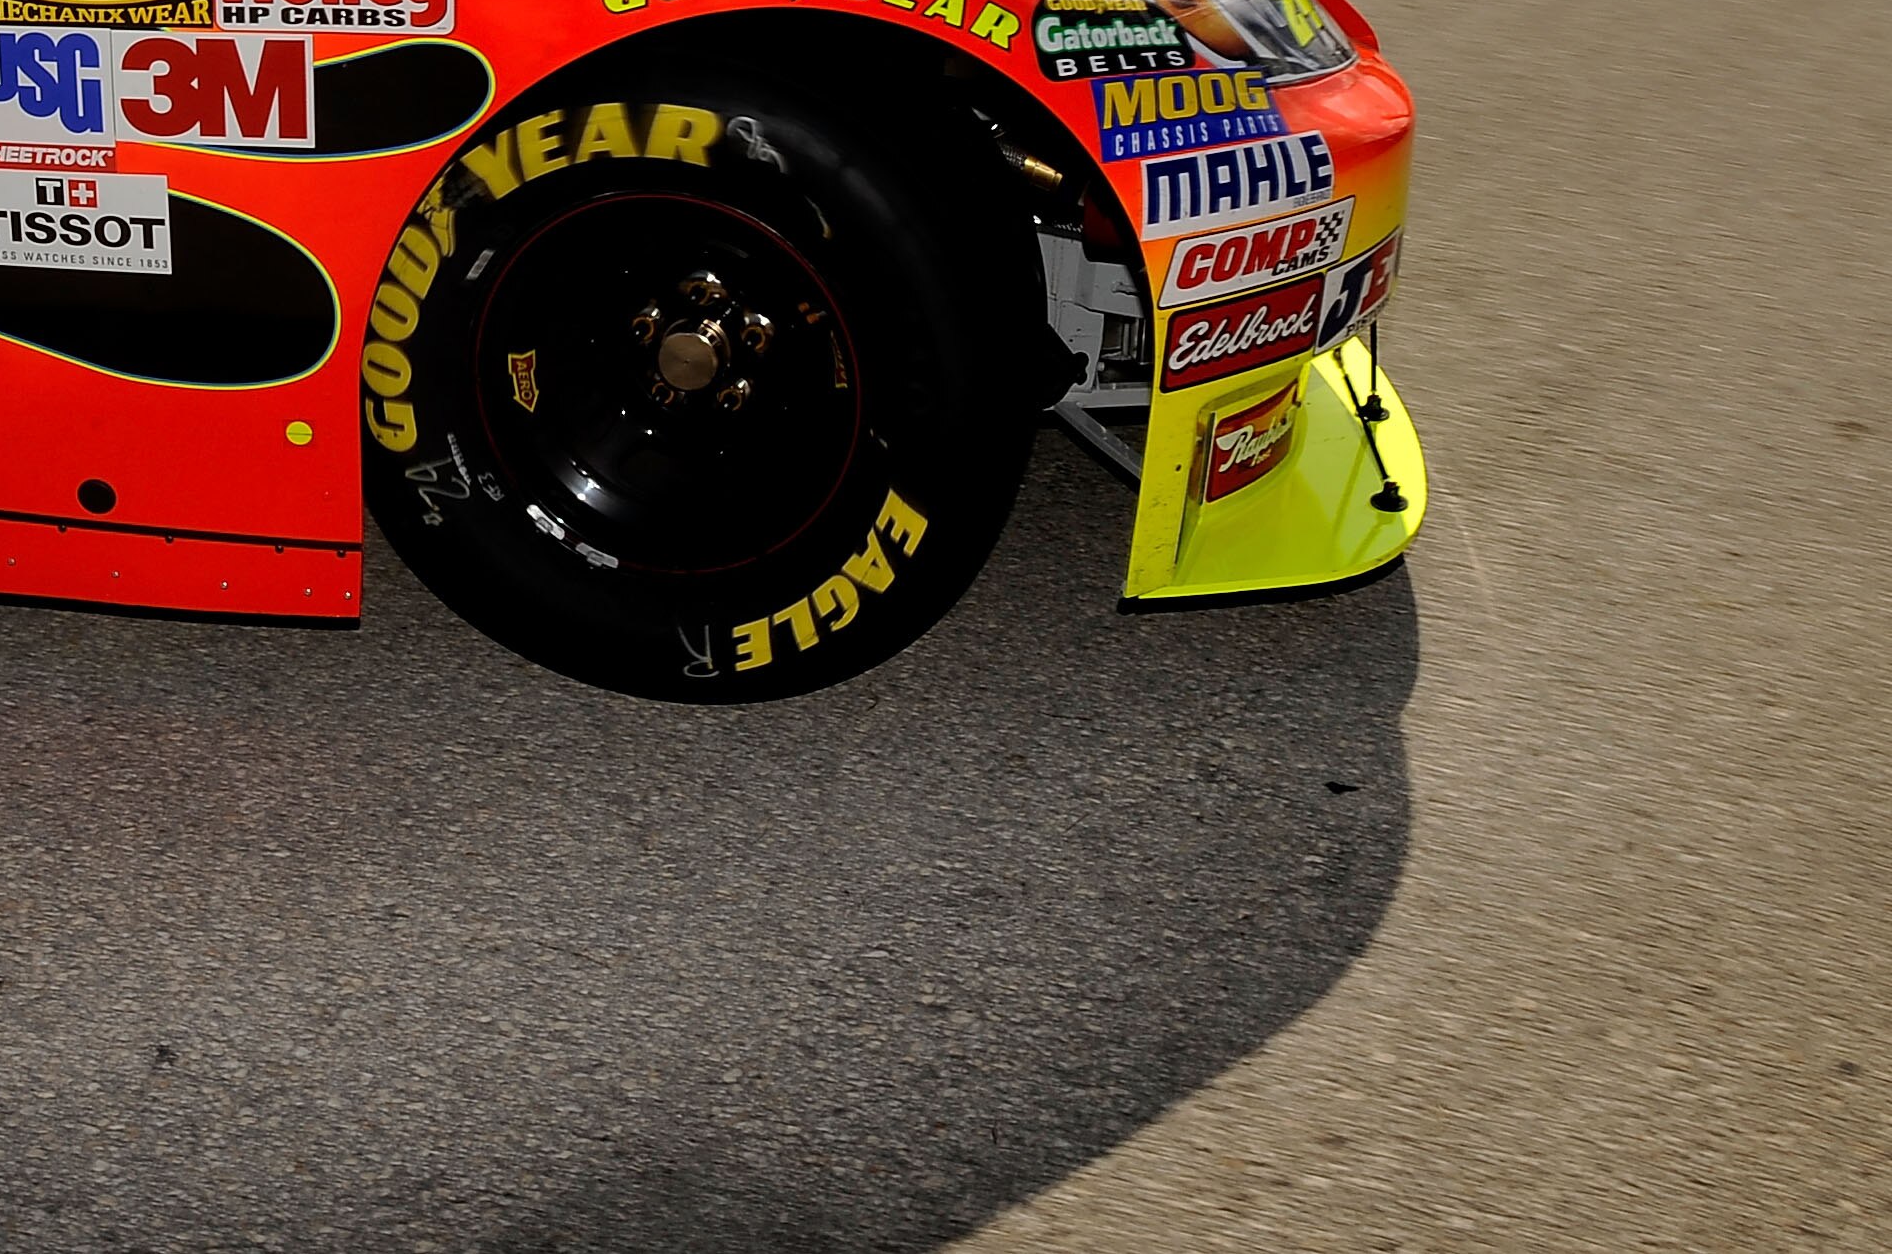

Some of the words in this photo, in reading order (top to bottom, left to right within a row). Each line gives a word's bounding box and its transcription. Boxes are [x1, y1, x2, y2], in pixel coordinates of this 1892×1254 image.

[222, 5, 272, 26] HP
[281, 6, 407, 27] CARBS
[1035, 16, 1179, 53] Gatorback
[1057, 50, 1186, 77] BELTS
[120, 36, 309, 140] 3M
[1102, 70, 1270, 130] MOOG
[1114, 124, 1209, 157] CHASSIS
[1222, 113, 1279, 139] PARTS
[1146, 134, 1333, 225] MAHLE
[23, 252, 85, 265] WATCHES
[92, 256, 133, 268] SINCE
[139, 258, 169, 269] 1853
[1175, 218, 1318, 290] COMP
[1270, 246, 1330, 277] CAMS
[1168, 294, 1317, 371] Edelbrock
[515, 360, 533, 401] AERO
[732, 487, 928, 672] EAGLE
